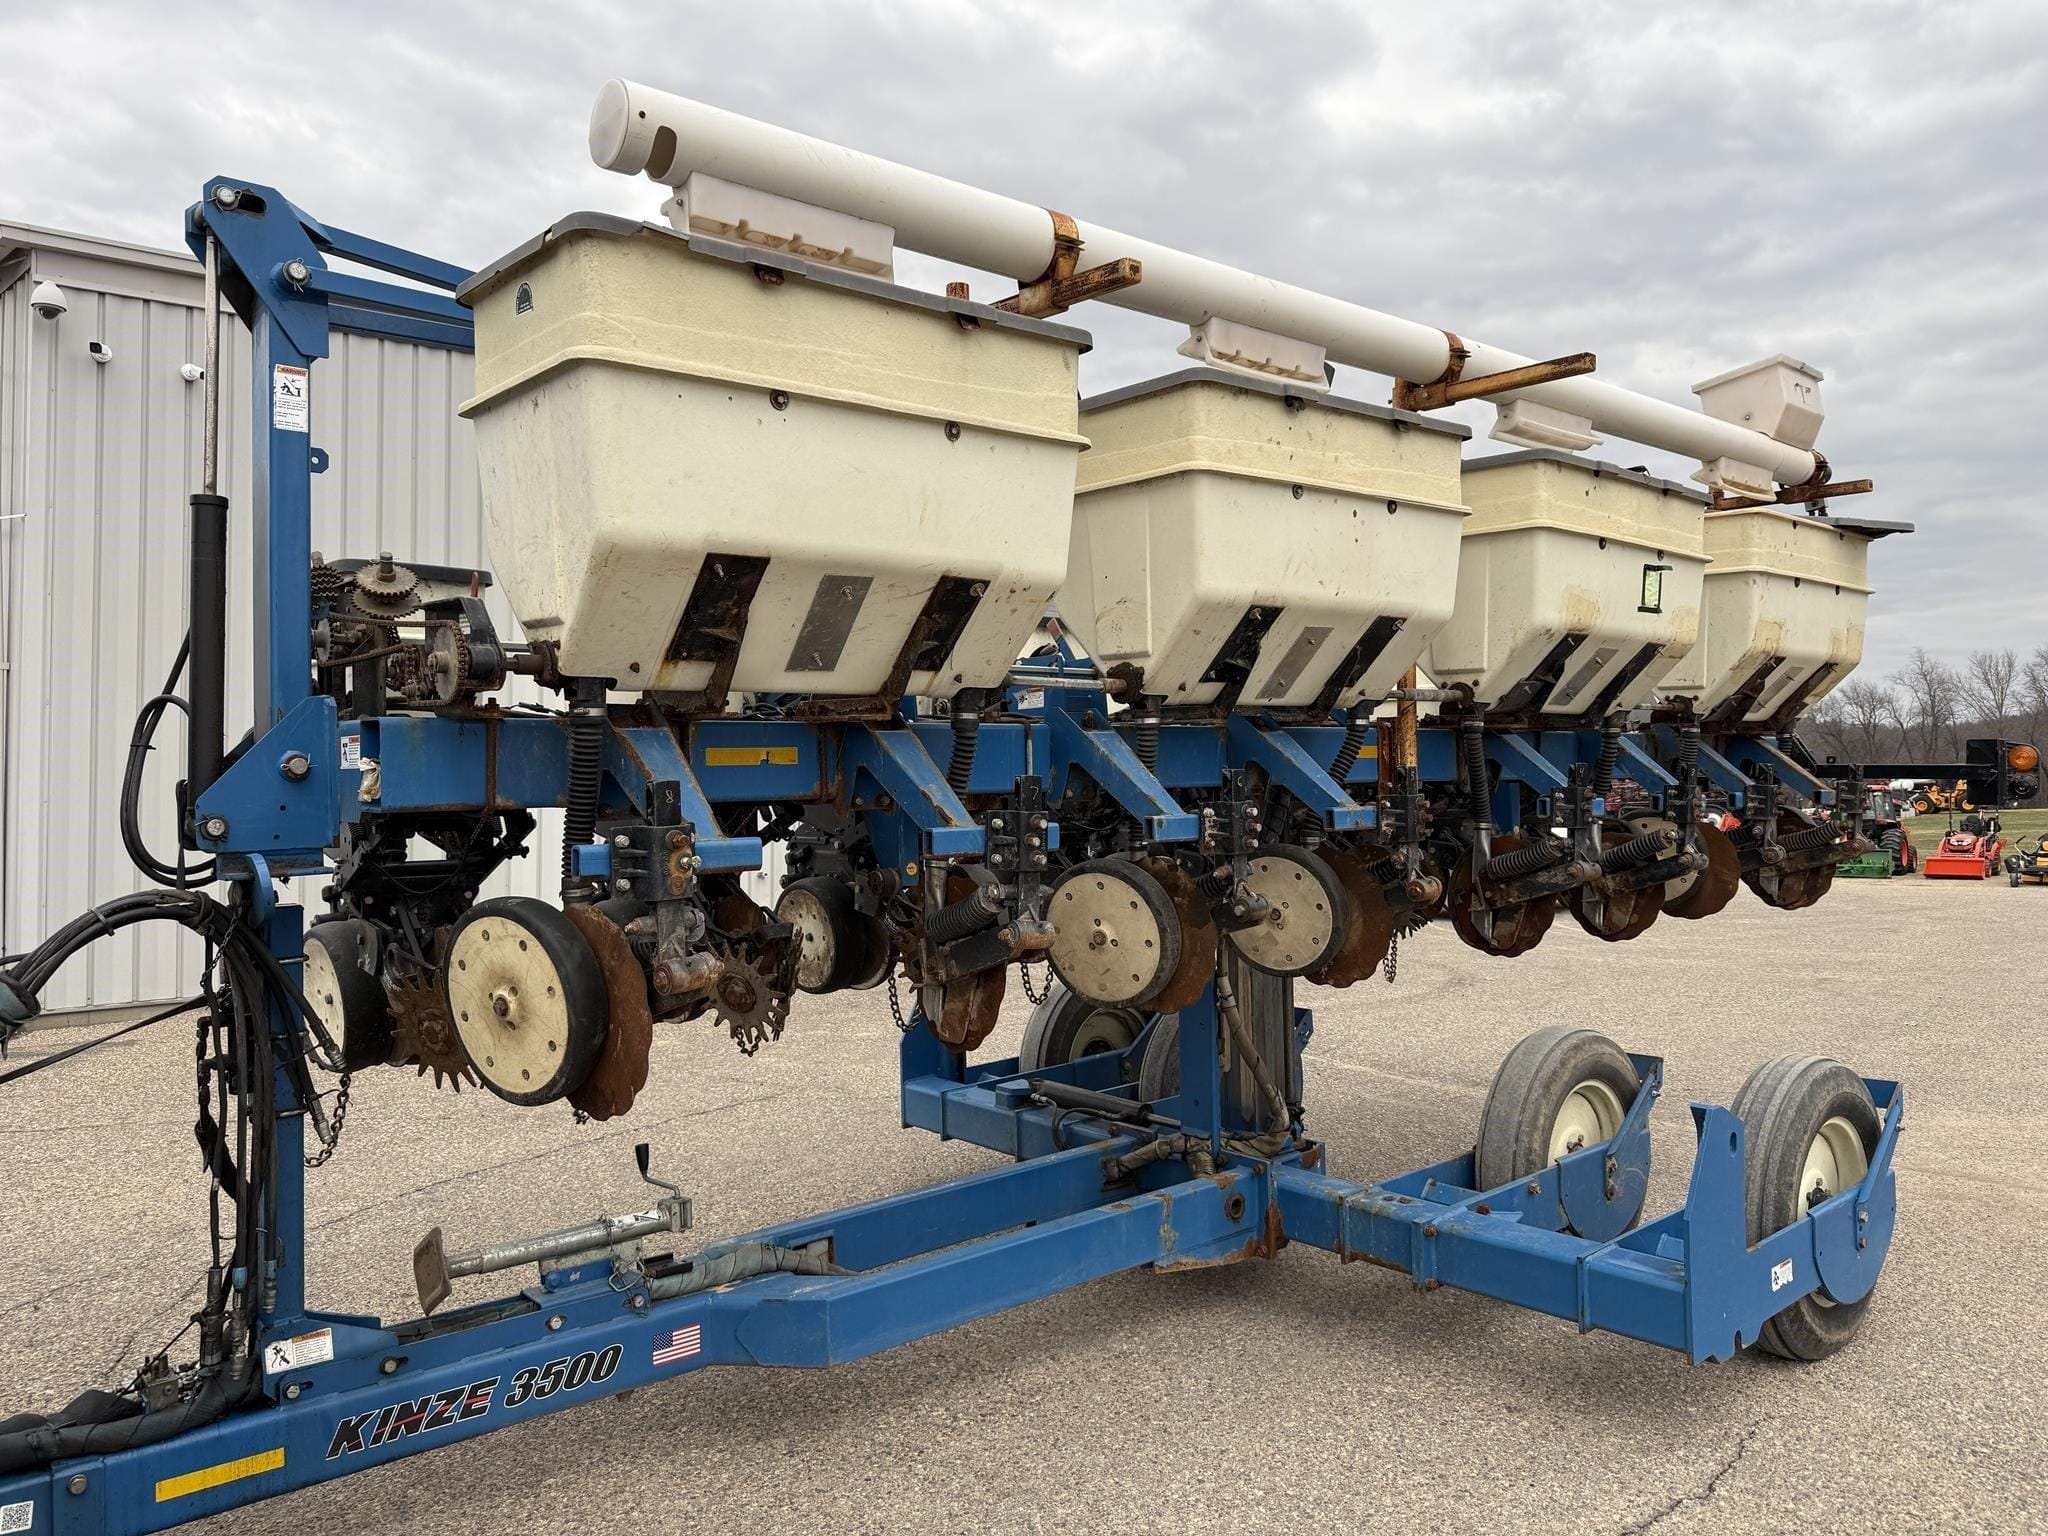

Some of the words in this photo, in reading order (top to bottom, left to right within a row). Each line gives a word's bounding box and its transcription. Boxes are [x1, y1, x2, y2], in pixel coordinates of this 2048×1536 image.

[665, 789, 674, 804] 8
[1030, 785, 1040, 800] 7
[325, 1376, 501, 1460] KINZE
[504, 1344, 624, 1409] 3500
